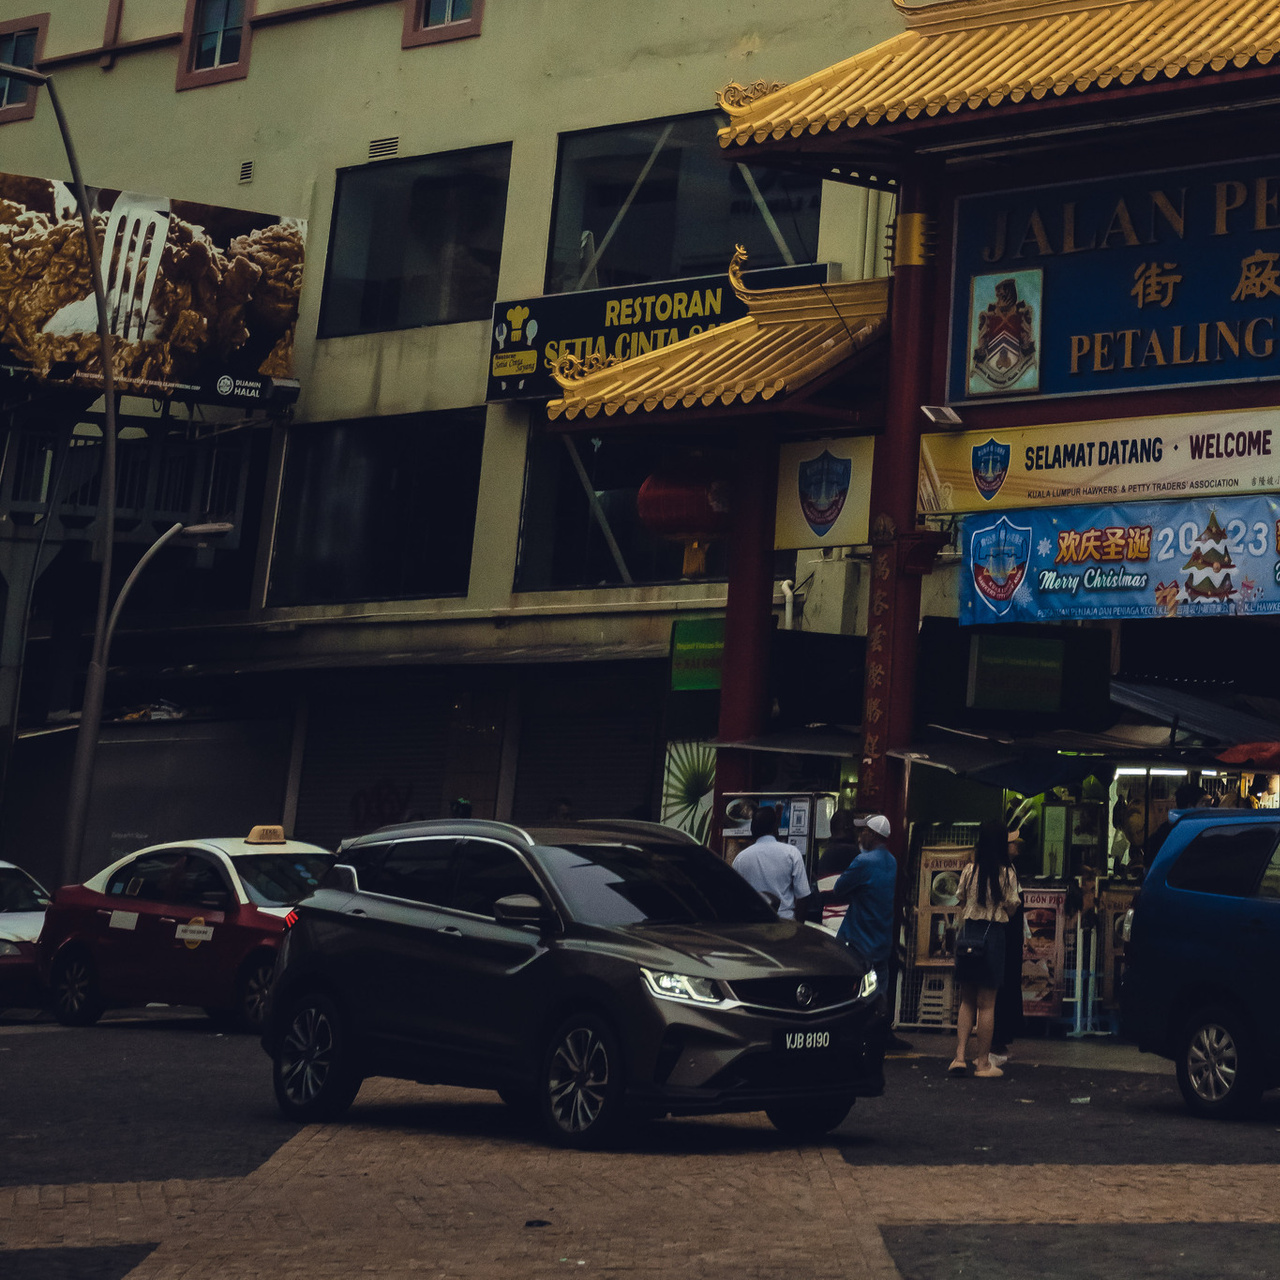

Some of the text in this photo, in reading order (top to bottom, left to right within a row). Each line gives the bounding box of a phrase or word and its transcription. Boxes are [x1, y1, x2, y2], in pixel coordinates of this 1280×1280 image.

[983, 187, 1190, 263] JALAN
[605, 287, 723, 327] RESTORAN
[1069, 316, 1275, 374] PETALING
[233, 386, 260, 398] HALAL
[234, 379, 262, 389] DIJAMIN
[1025, 429, 1272, 471] SELAMAT DATANG WELCOME
[1027, 490, 1051, 500] KUALA
[1052, 488, 1081, 499] LUMPUR
[1121, 485, 1127, 493] &
[1128, 483, 1151, 493] PETTY
[1189, 478, 1240, 489] ASSOCIATION
[1055, 526, 1152, 564] 欢庆圣诞
[1038, 569, 1078, 593] Merry
[1083, 566, 1148, 590] Christmas
[1098, 607, 1113, 616] DAN
[785, 1031, 830, 1050] VJB 8190
